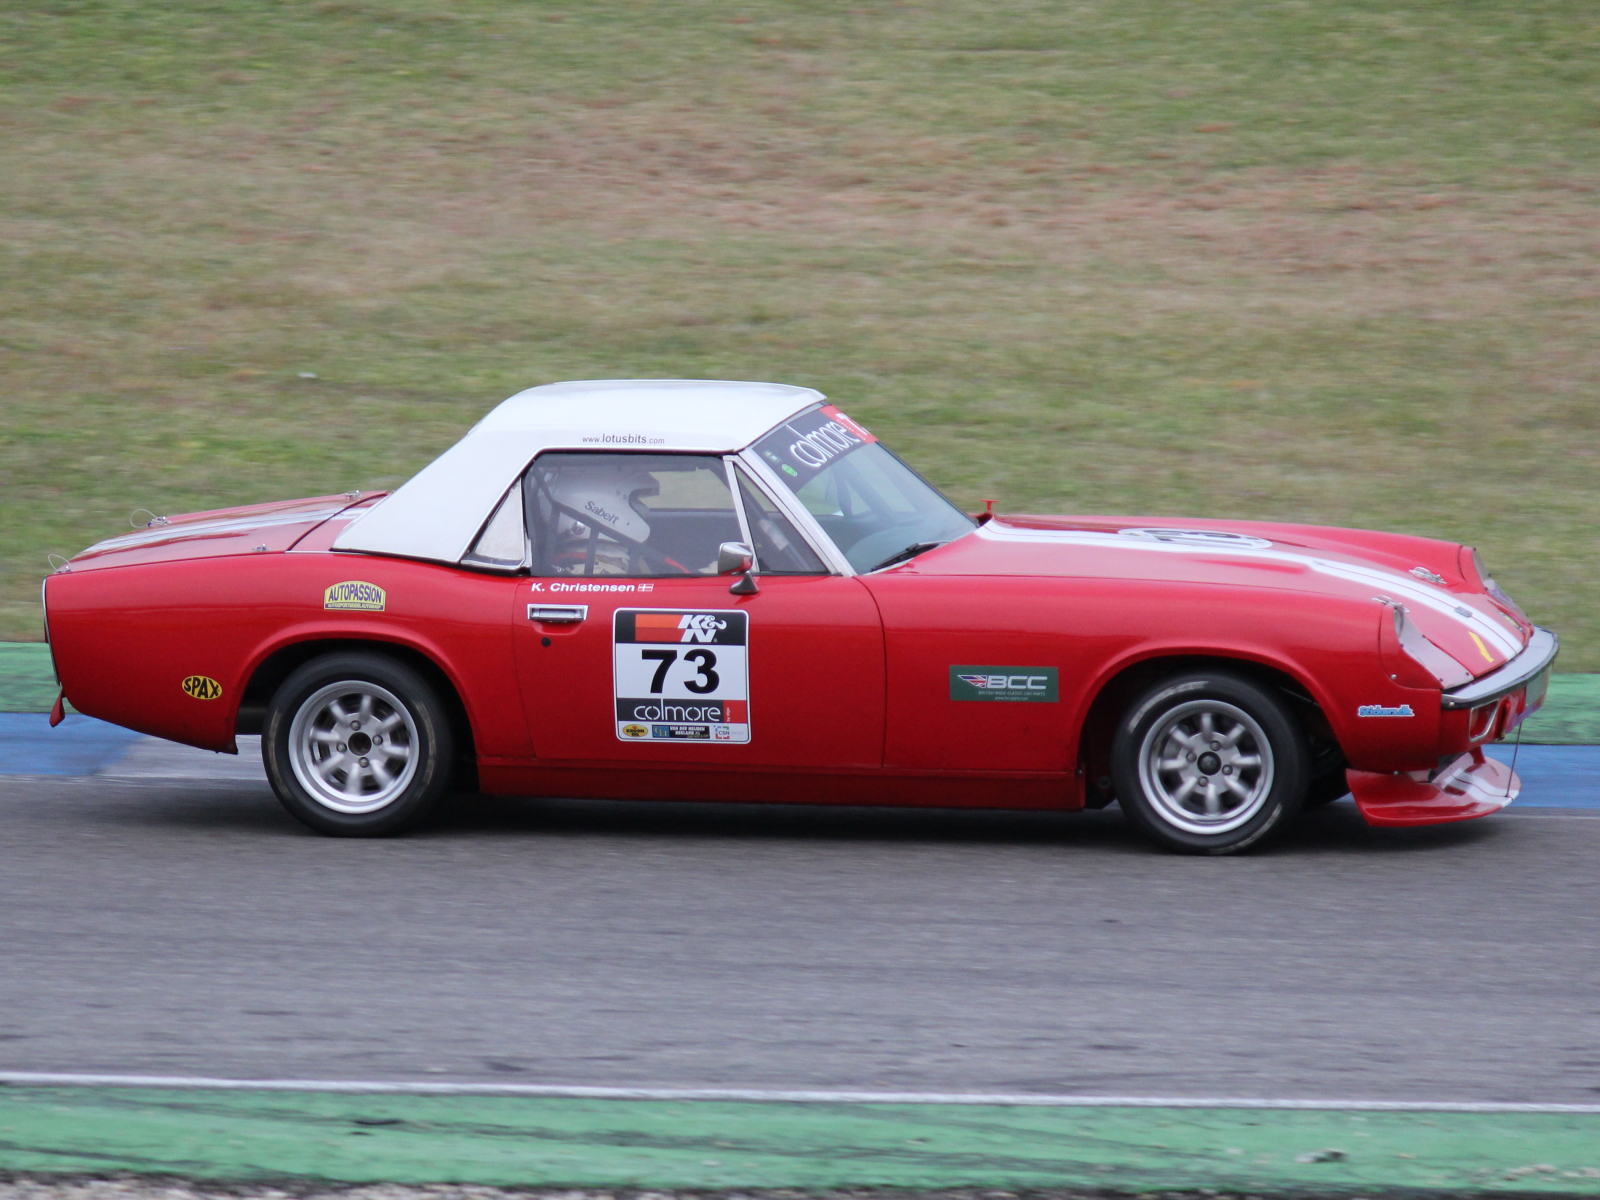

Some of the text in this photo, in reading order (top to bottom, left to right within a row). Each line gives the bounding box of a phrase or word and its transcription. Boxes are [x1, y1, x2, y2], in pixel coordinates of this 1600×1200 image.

[582, 433, 665, 444] www.lotusbits.com
[786, 421, 861, 467] colmore
[584, 500, 620, 525] Sabelt
[328, 583, 382, 603] AUTOPASSION
[531, 583, 636, 592] K. Christensen
[642, 648, 720, 694] 73
[987, 675, 1048, 690] BCC
[183, 676, 220, 699] SPAX
[634, 698, 721, 722] colmore
